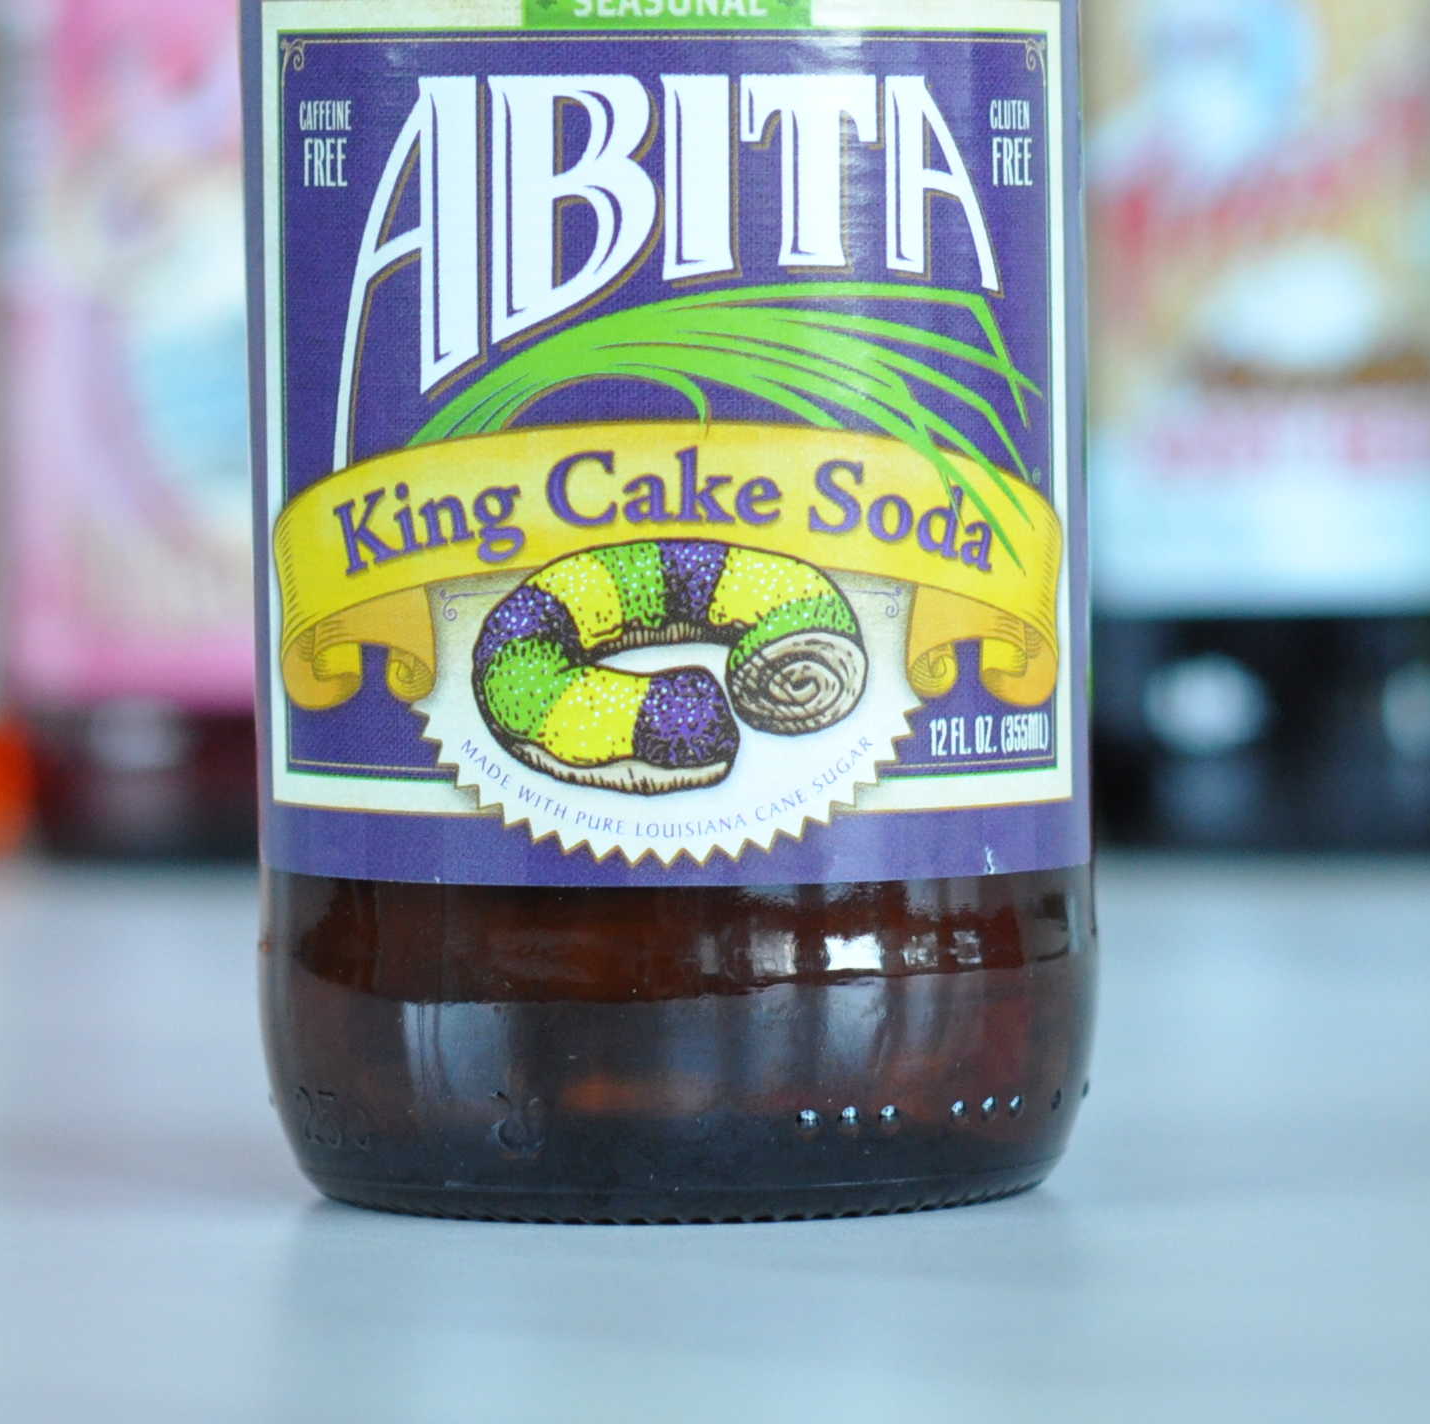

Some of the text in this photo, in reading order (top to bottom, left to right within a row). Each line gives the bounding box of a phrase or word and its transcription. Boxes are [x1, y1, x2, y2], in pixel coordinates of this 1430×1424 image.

[298, 100, 352, 131] CAFFEINE
[989, 99, 1031, 131] GLUTEN
[303, 137, 348, 187] FREE
[992, 137, 1033, 187] FREE
[334, 74, 1001, 473] ABITA
[332, 445, 993, 577] King Cake Soda
[929, 711, 1049, 756] 12 FL. OZ. (355ML)
[460, 736, 874, 838] MADE WITH PURE LOUISIANA CANE SUGAR
